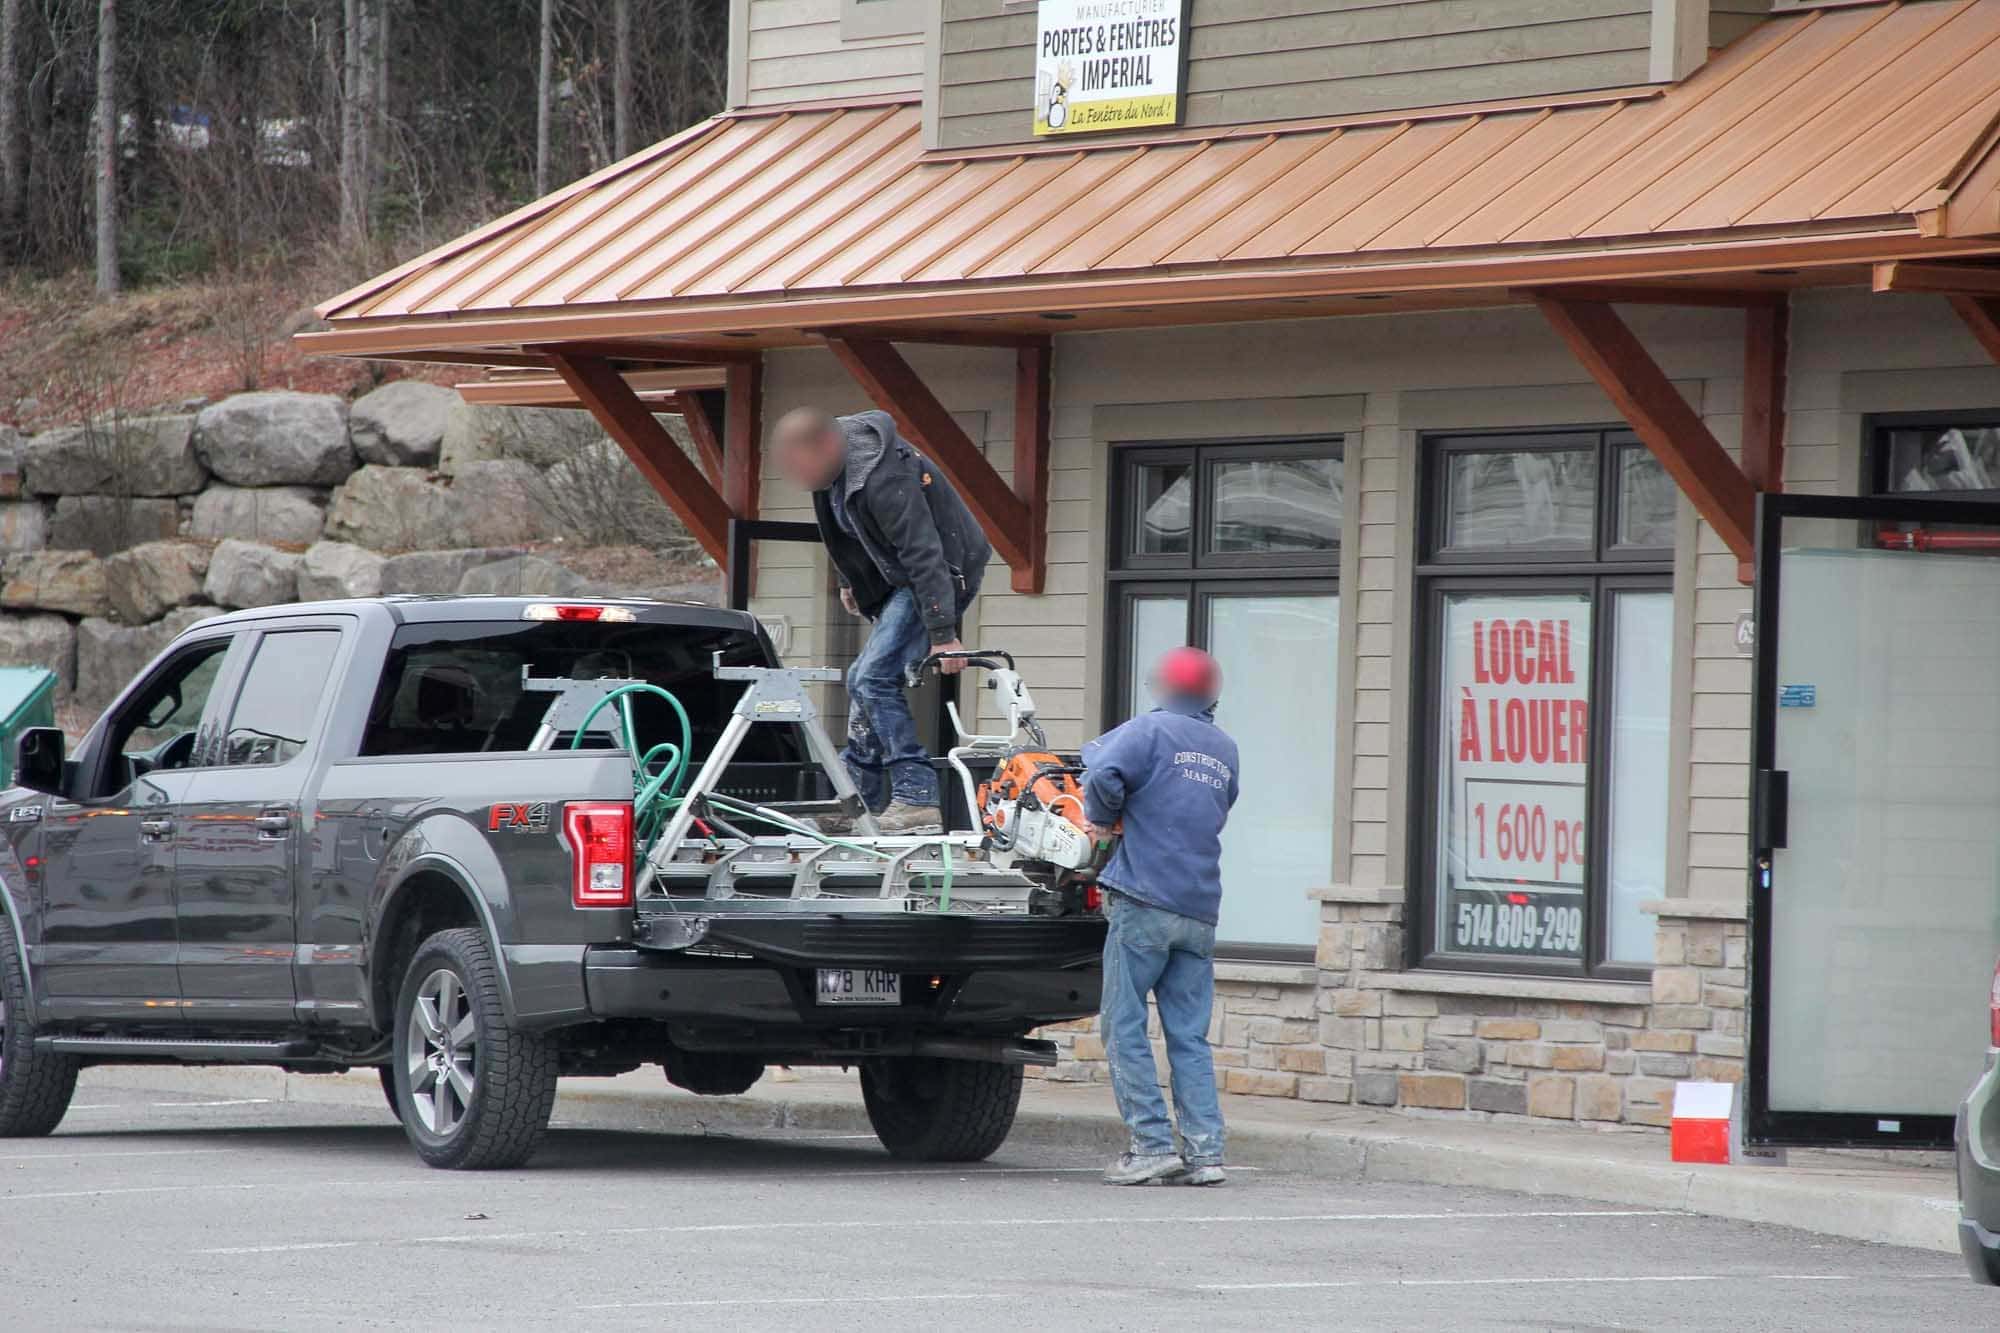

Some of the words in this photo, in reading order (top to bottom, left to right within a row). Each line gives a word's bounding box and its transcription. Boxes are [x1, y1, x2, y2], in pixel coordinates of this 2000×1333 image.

[1043, 26, 1093, 58] PORTES
[1096, 25, 1106, 53] &
[1109, 16, 1176, 51] FENÊTRES
[1081, 55, 1153, 91] IMPERIAL
[1071, 109, 1083, 125] La
[1086, 104, 1122, 124] Fenêtre
[1124, 101, 1138, 120] du
[1140, 98, 1164, 118] Nord
[1473, 618, 1576, 685] LOCAL
[1459, 686, 1483, 762] À
[1489, 697, 1588, 764] LOUER
[488, 802, 550, 832] FX4
[1474, 802, 1486, 860] 1
[1496, 802, 1547, 863] 600
[1457, 902, 1493, 946] 514
[1495, 903, 1583, 951] 809-299
[864, 970, 897, 993] KHR
